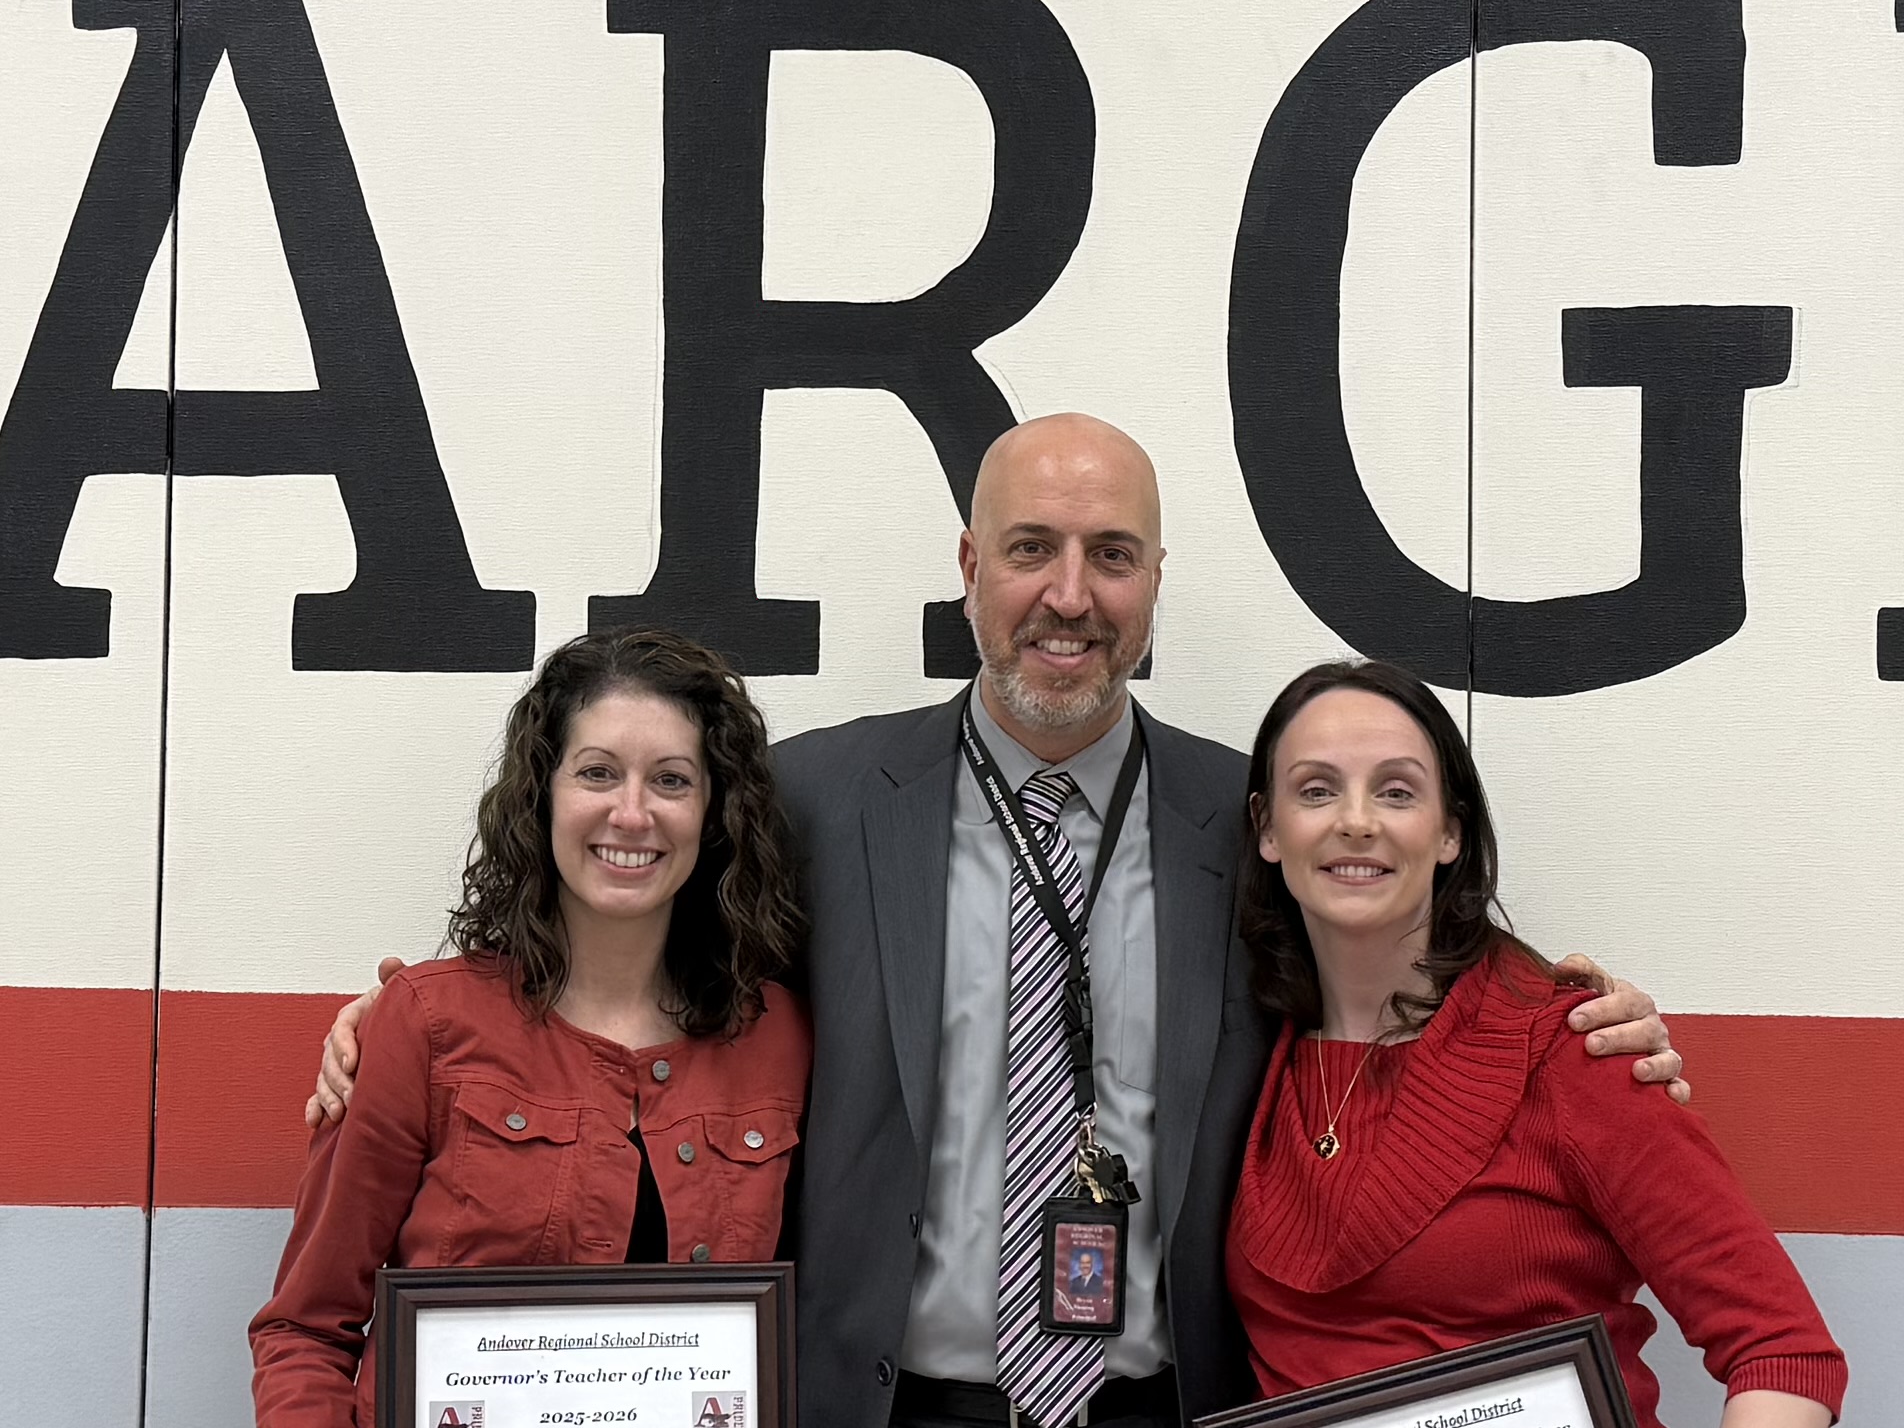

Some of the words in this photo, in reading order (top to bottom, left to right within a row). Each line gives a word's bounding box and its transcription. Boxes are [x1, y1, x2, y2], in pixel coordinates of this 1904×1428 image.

[477, 1335, 536, 1352] Andover
[538, 1333, 598, 1351] Regional
[601, 1332, 645, 1348] School
[648, 1332, 699, 1347] District
[446, 1370, 549, 1387] Governor's
[553, 1368, 627, 1384] Teacher
[631, 1367, 653, 1385] of
[654, 1367, 683, 1381] the
[688, 1367, 731, 1381] Year
[539, 1408, 638, 1426] 2025-2026
[733, 1397, 744, 1428] PRIDE
[1471, 1397, 1524, 1424] District
